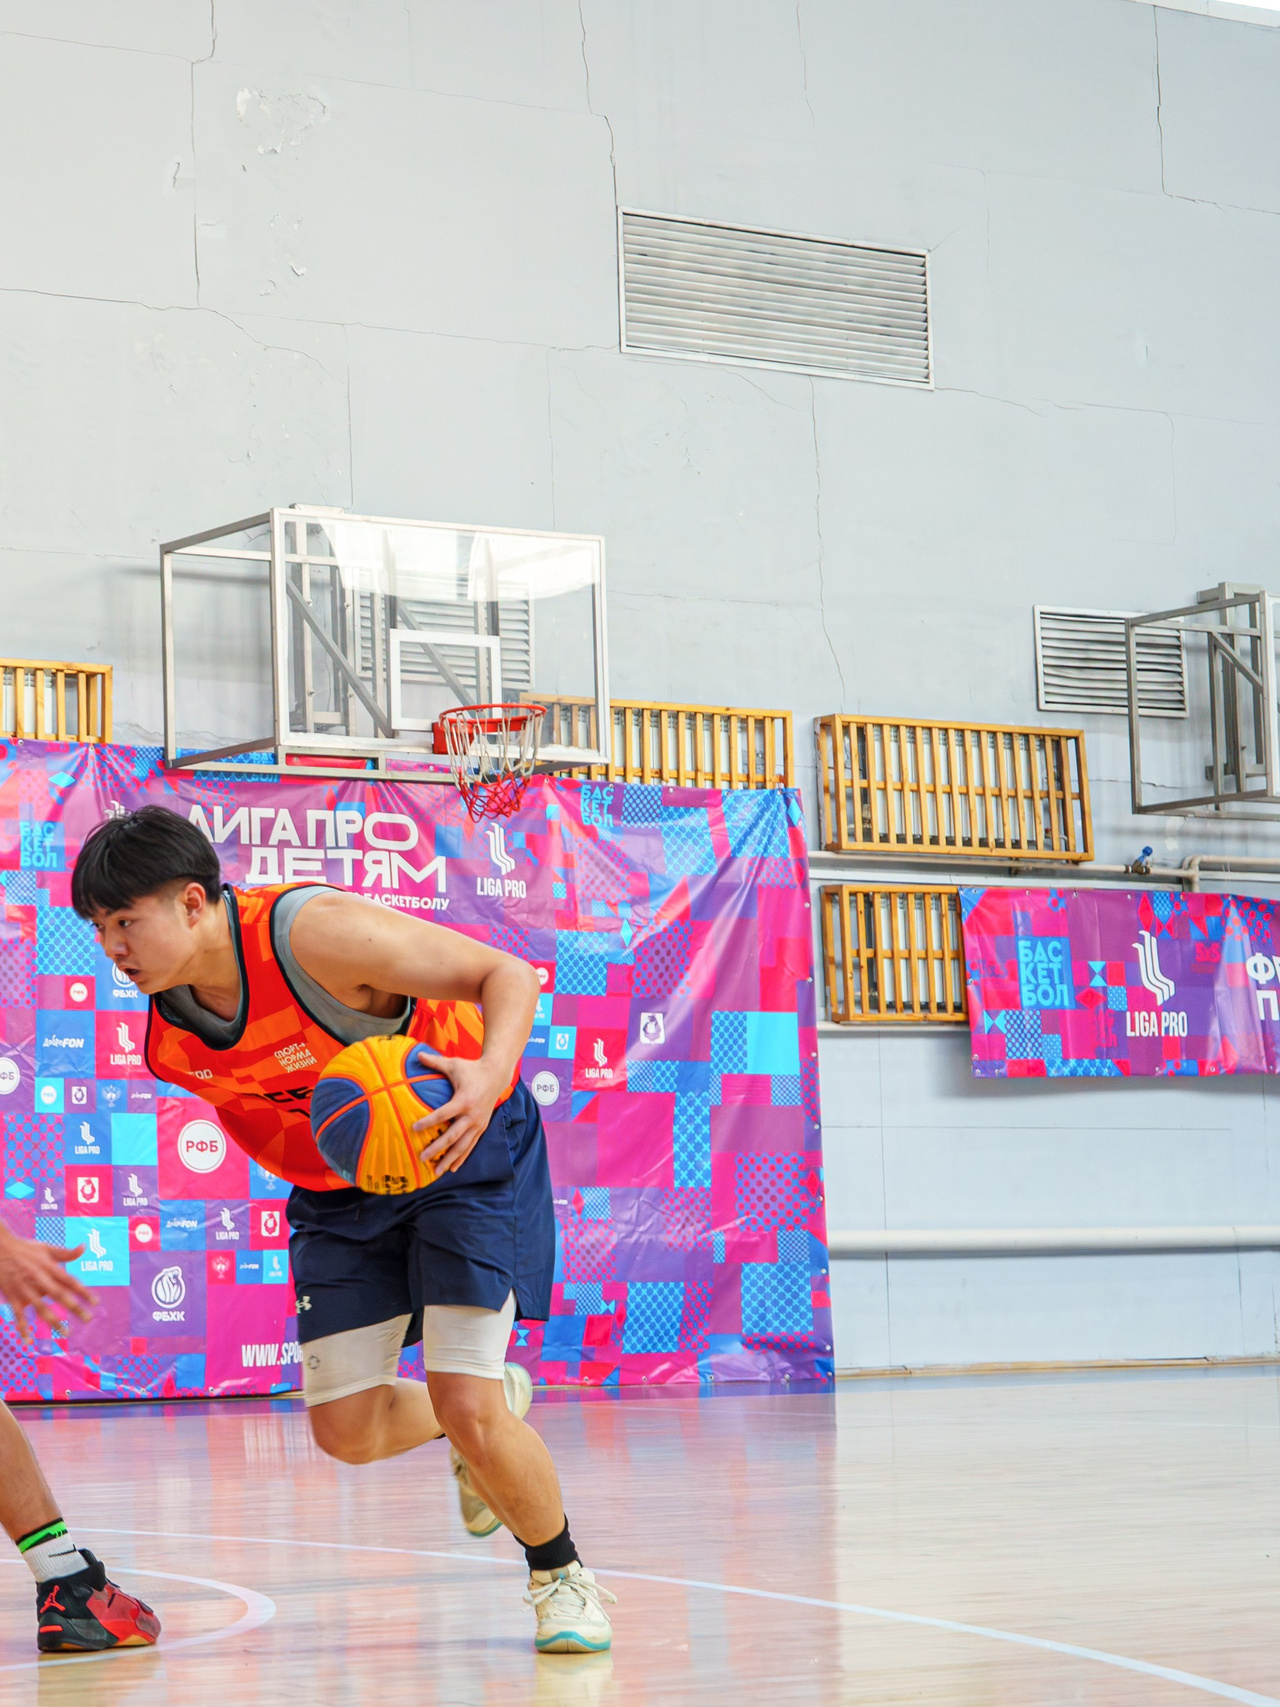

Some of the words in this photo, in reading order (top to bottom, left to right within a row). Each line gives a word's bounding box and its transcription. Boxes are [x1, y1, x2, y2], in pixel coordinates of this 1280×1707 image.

[582, 785, 615, 800] БАС
[581, 800, 613, 815] КЕТ
[187, 804, 301, 846] ЛИГА
[306, 809, 419, 851] ПРО
[582, 812, 614, 827] БОЛ
[19, 821, 56, 837] БАС
[20, 836, 54, 852] КЕТ
[21, 851, 58, 868] БОЛ
[245, 847, 446, 893] ДЕТЯМ
[476, 876, 503, 897] LIGA
[504, 879, 527, 899] PRO
[1018, 940, 1063, 962] БАС
[1020, 962, 1062, 985] КЕТ
[1022, 984, 1070, 1007] БОЛ
[1126, 1011, 1159, 1037] LIGA
[1161, 1011, 1188, 1038] PRO
[110, 1054, 126, 1065] LIGA
[127, 1054, 141, 1065] PRO
[278, 1048, 312, 1067] НОРМА
[284, 1056, 318, 1073] ЖИЗНИ
[585, 1068, 599, 1078] LIGA
[600, 1069, 613, 1078] PRO
[536, 1084, 555, 1093] РФБ
[186, 1139, 219, 1153] РФБ
[81, 1261, 98, 1271] LIGA
[99, 1261, 113, 1271] PRO
[153, 1311, 185, 1321] ФБХК
